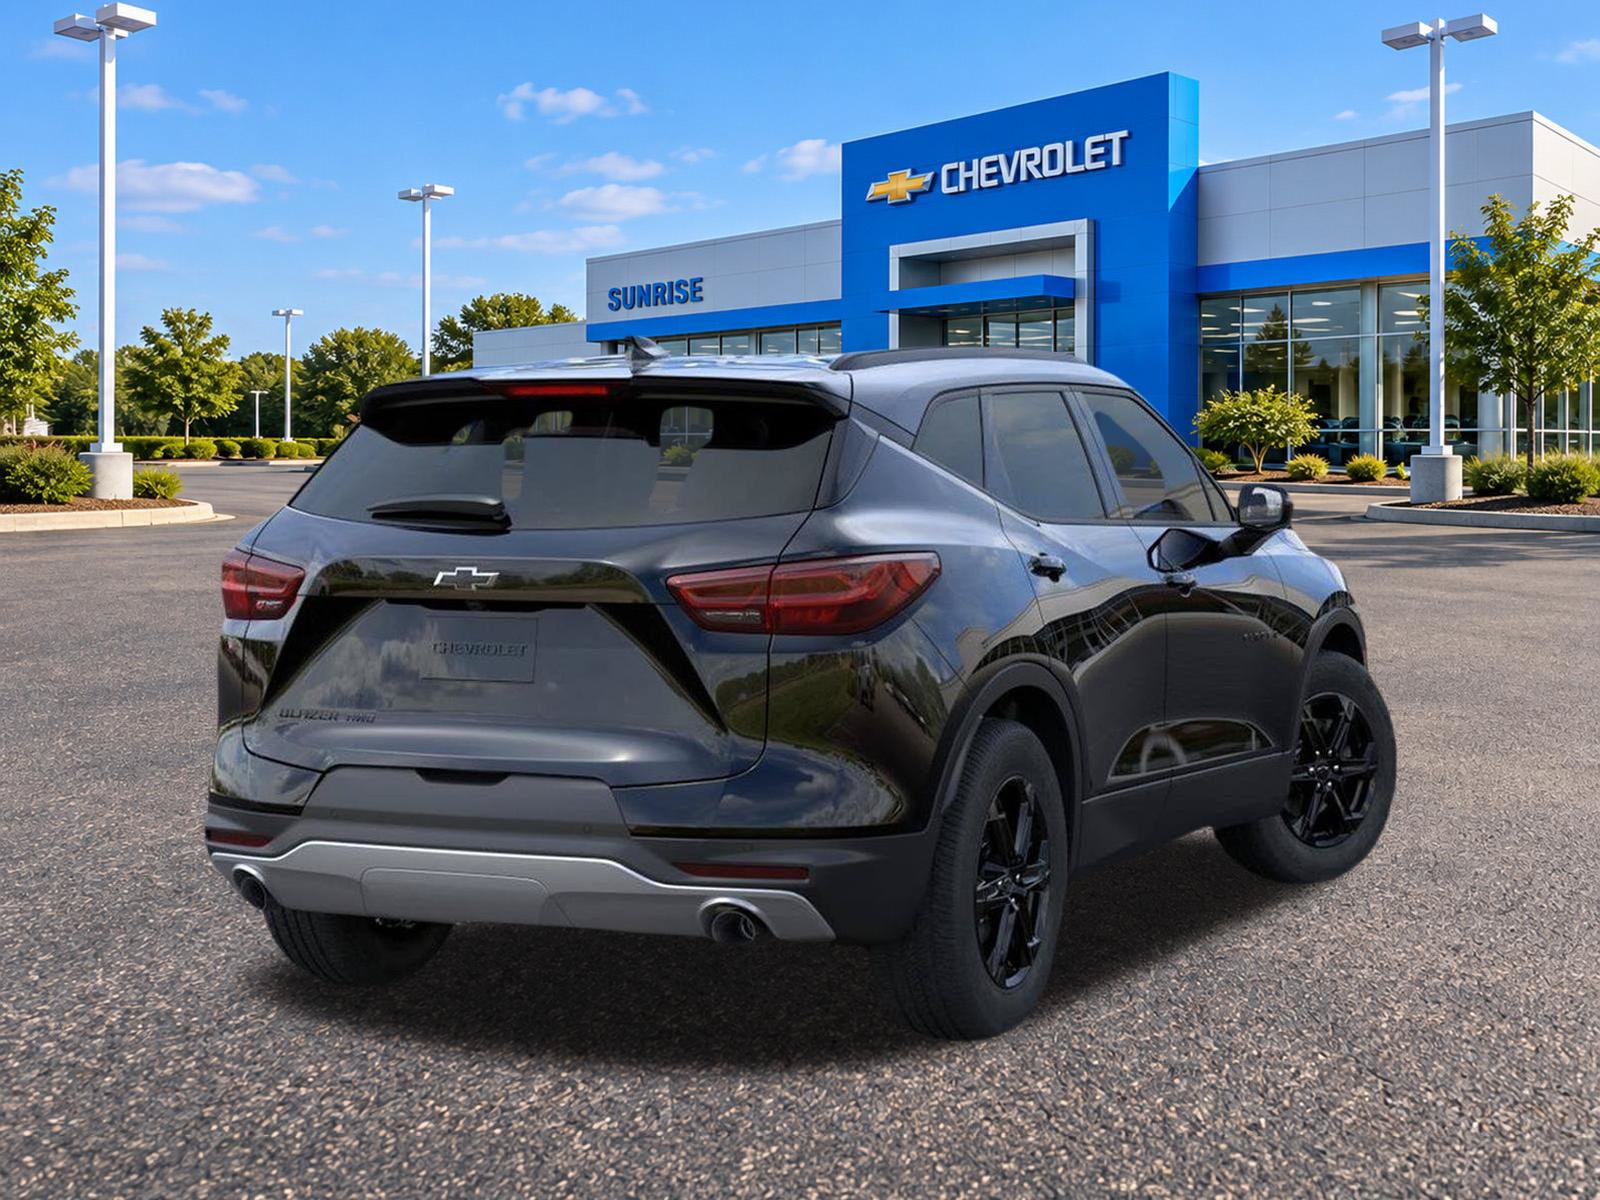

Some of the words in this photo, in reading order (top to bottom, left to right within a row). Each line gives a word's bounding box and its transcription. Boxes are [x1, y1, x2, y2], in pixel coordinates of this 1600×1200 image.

[941, 130, 1129, 194] CHEVROLET
[608, 277, 704, 311] SUNRISE
[433, 641, 528, 656] CHEVROLET
